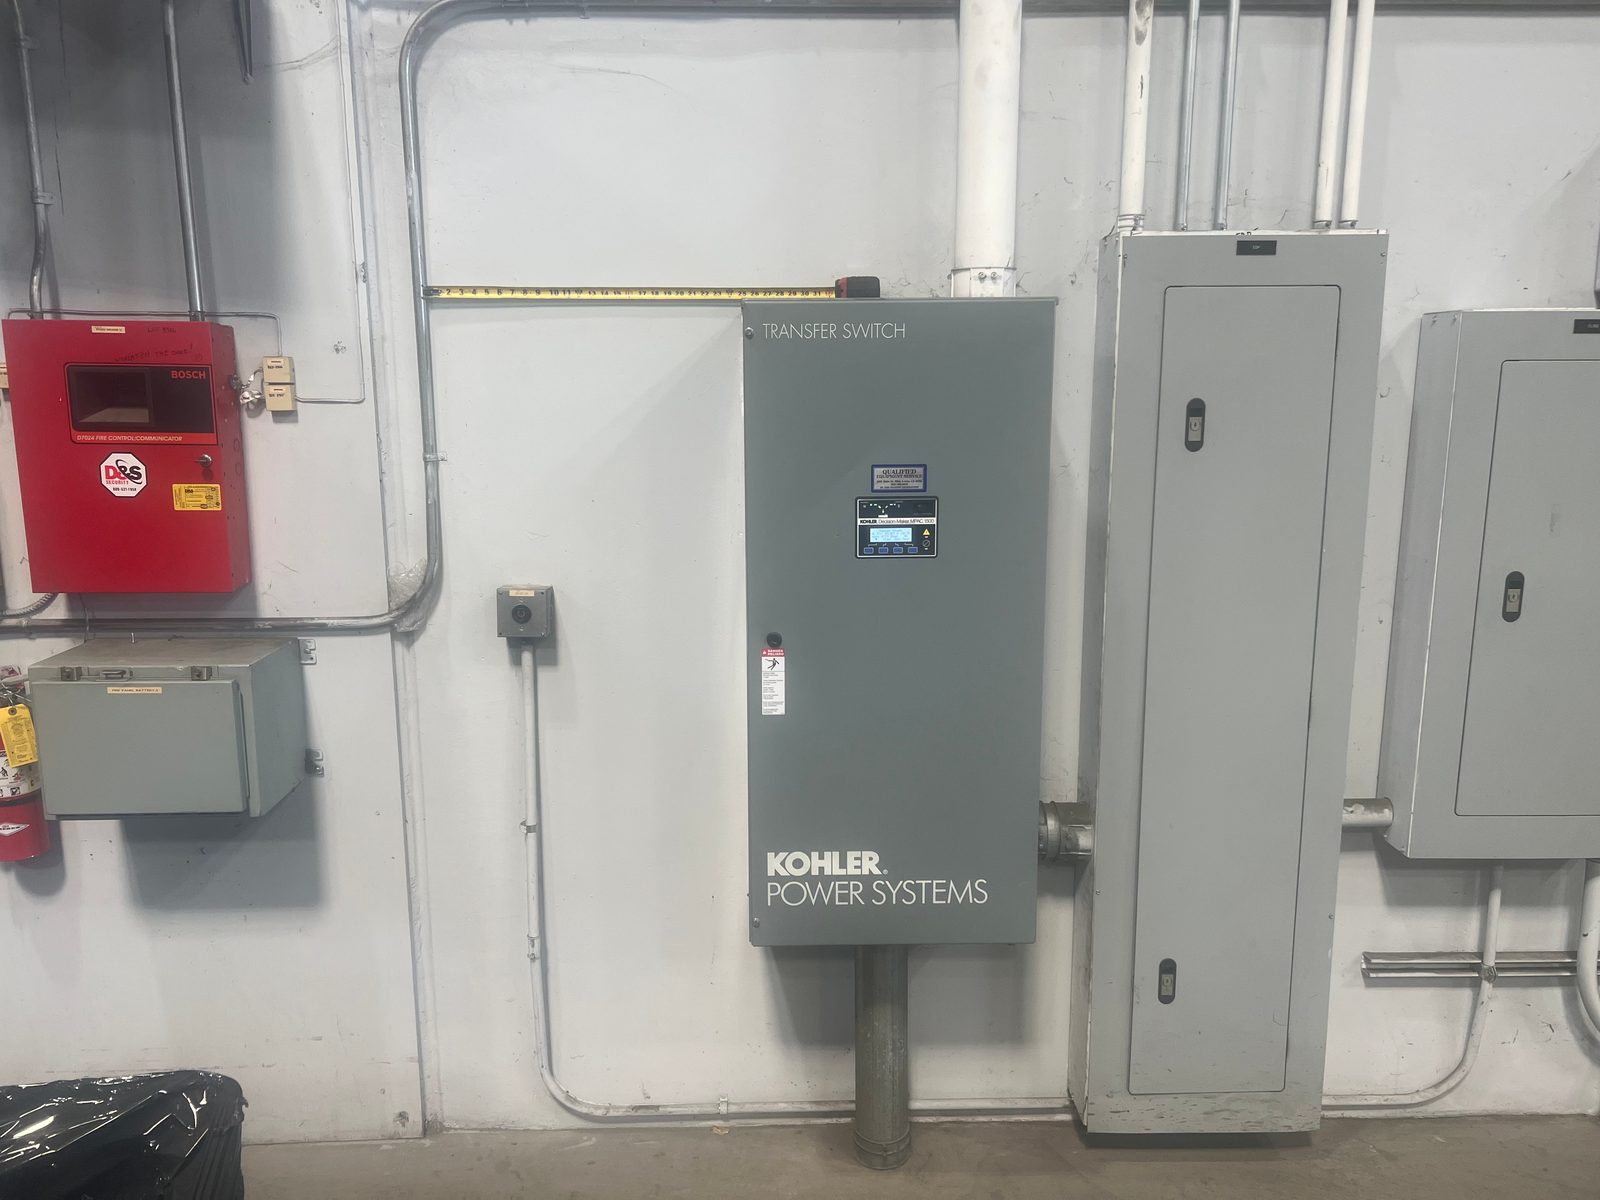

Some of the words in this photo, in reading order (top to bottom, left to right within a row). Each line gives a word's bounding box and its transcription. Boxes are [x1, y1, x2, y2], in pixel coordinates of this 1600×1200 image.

[762, 323, 836, 339] TRANSFER
[842, 322, 906, 339] SWITCH
[171, 370, 206, 379] BOSCH
[105, 463, 142, 481] D&S
[767, 850, 882, 876] KOHLER
[767, 881, 864, 906] POWER
[872, 879, 988, 905] SYSTEMS
